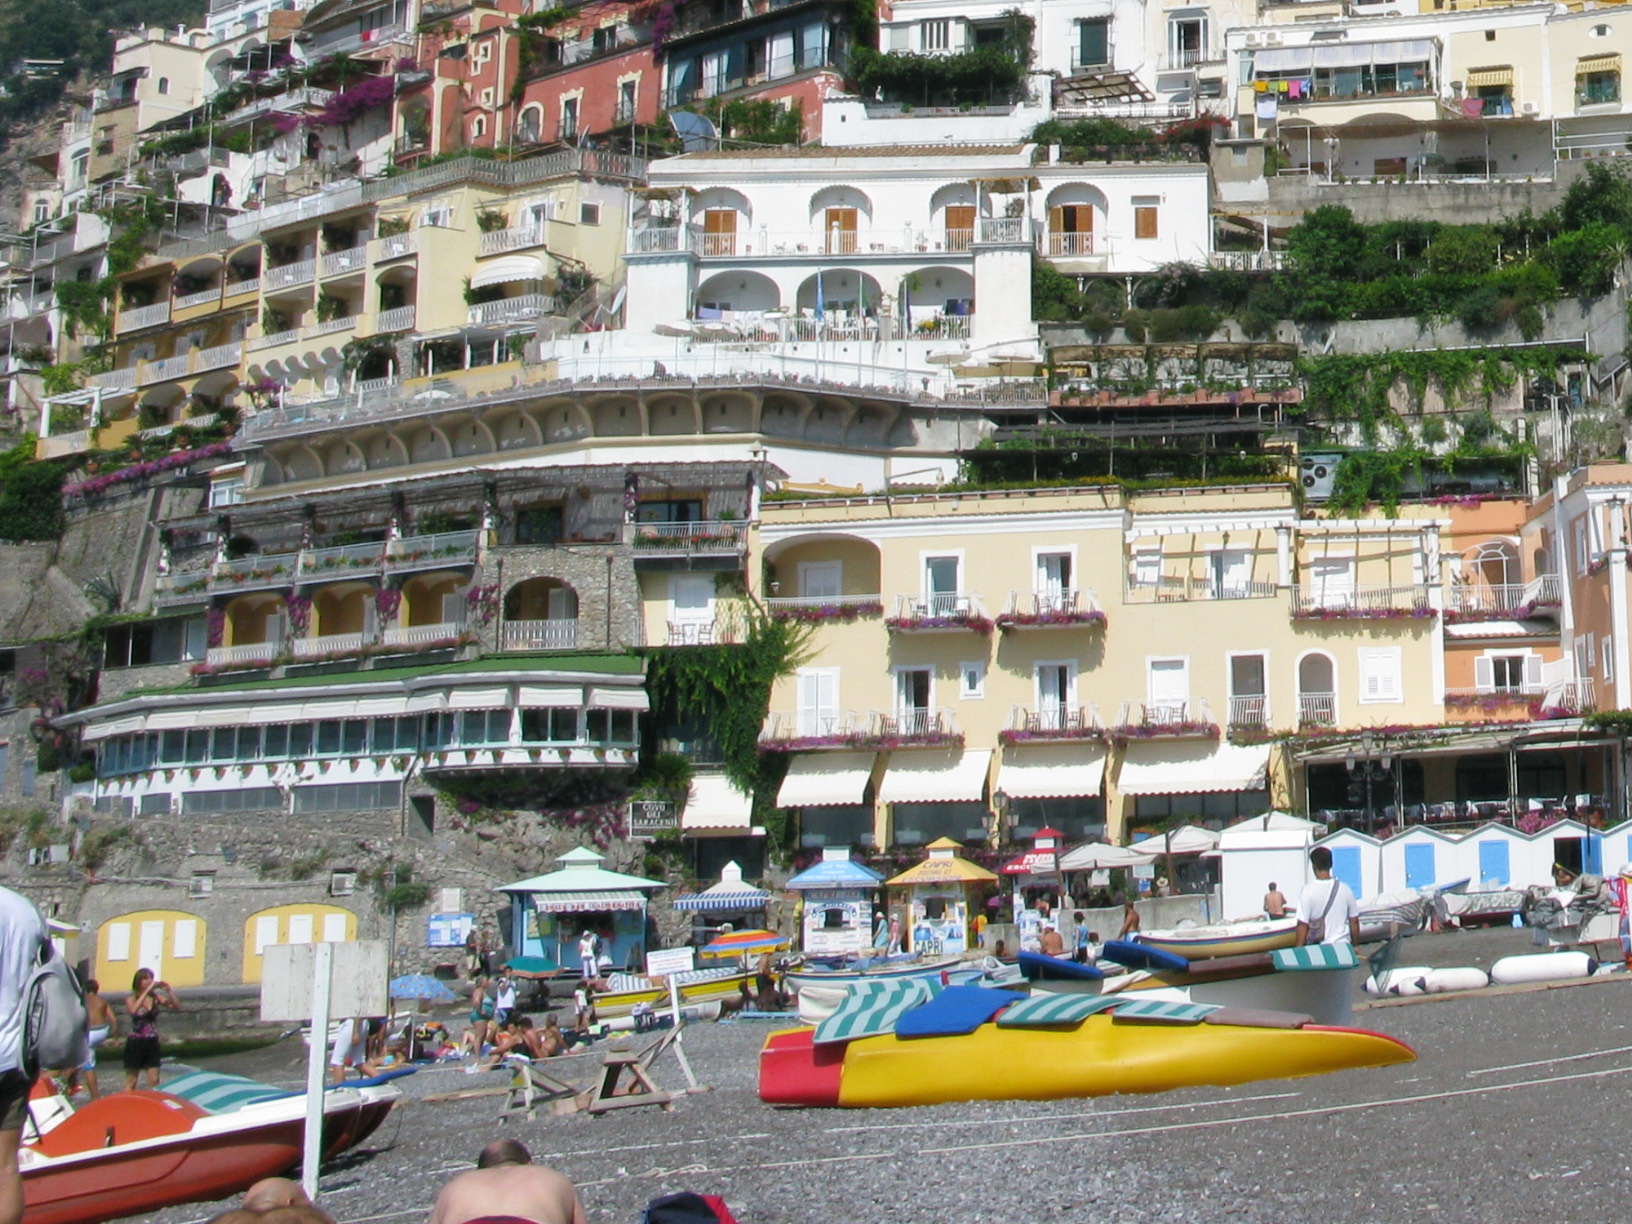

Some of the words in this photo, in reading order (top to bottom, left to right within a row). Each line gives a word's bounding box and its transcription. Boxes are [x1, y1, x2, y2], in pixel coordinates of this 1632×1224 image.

[642, 802, 666, 811] COVO
[923, 861, 954, 869] CAPRI
[914, 940, 944, 954] CAPRI
